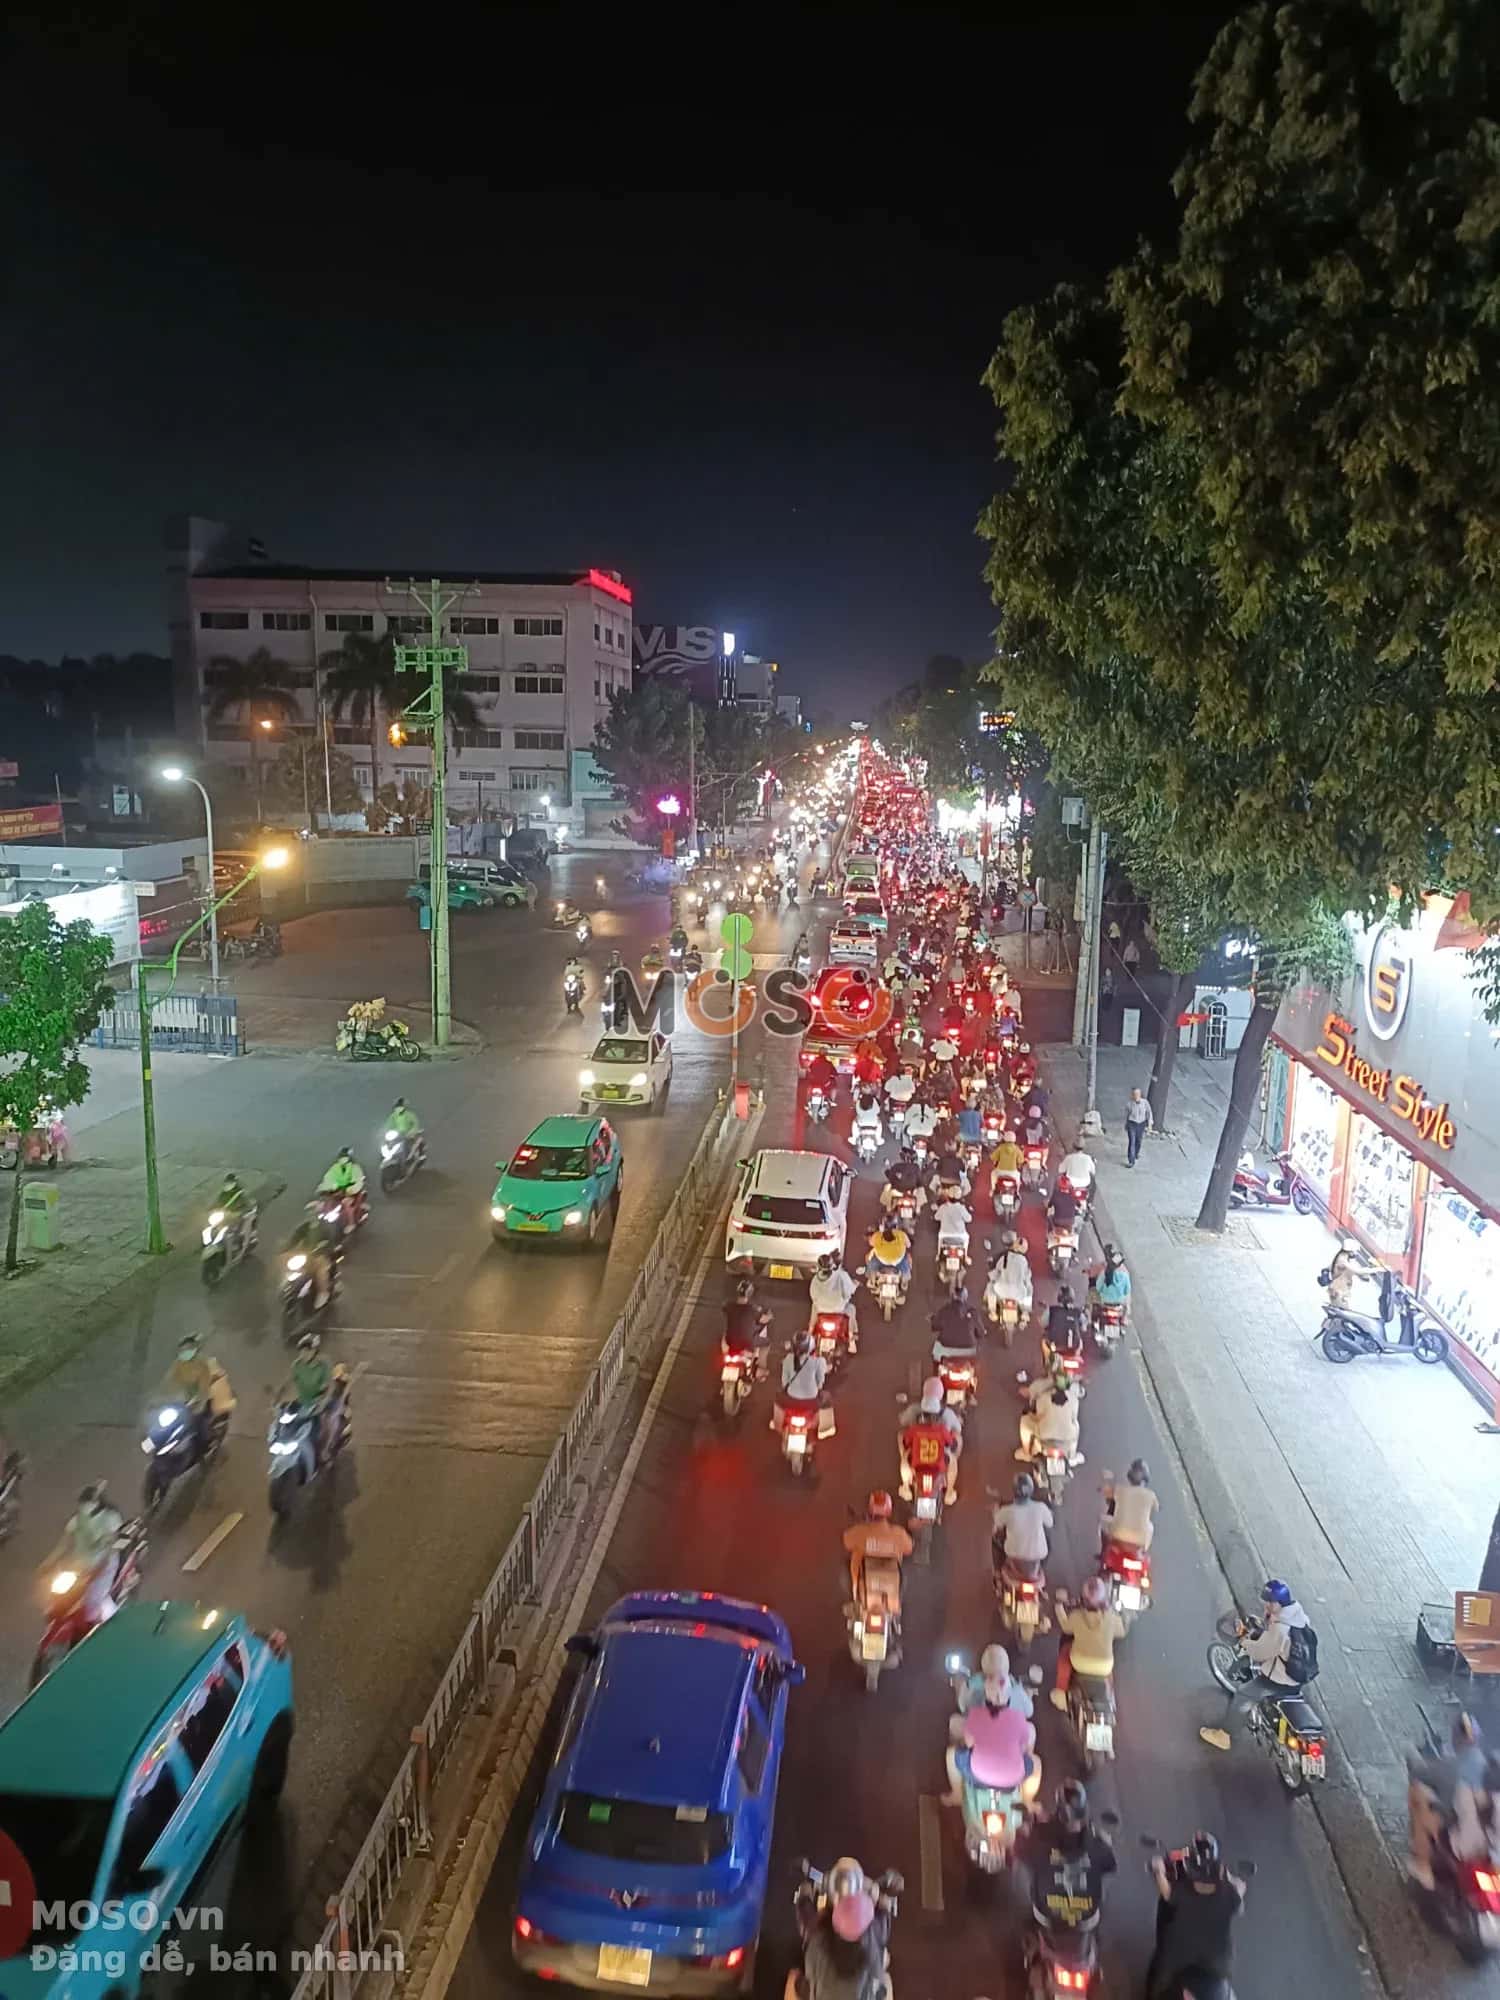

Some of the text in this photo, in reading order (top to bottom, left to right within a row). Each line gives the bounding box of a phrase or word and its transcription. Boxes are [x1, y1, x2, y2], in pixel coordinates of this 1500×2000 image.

[632, 626, 717, 660] VUS
[1316, 1012, 1457, 1149] Street Style
